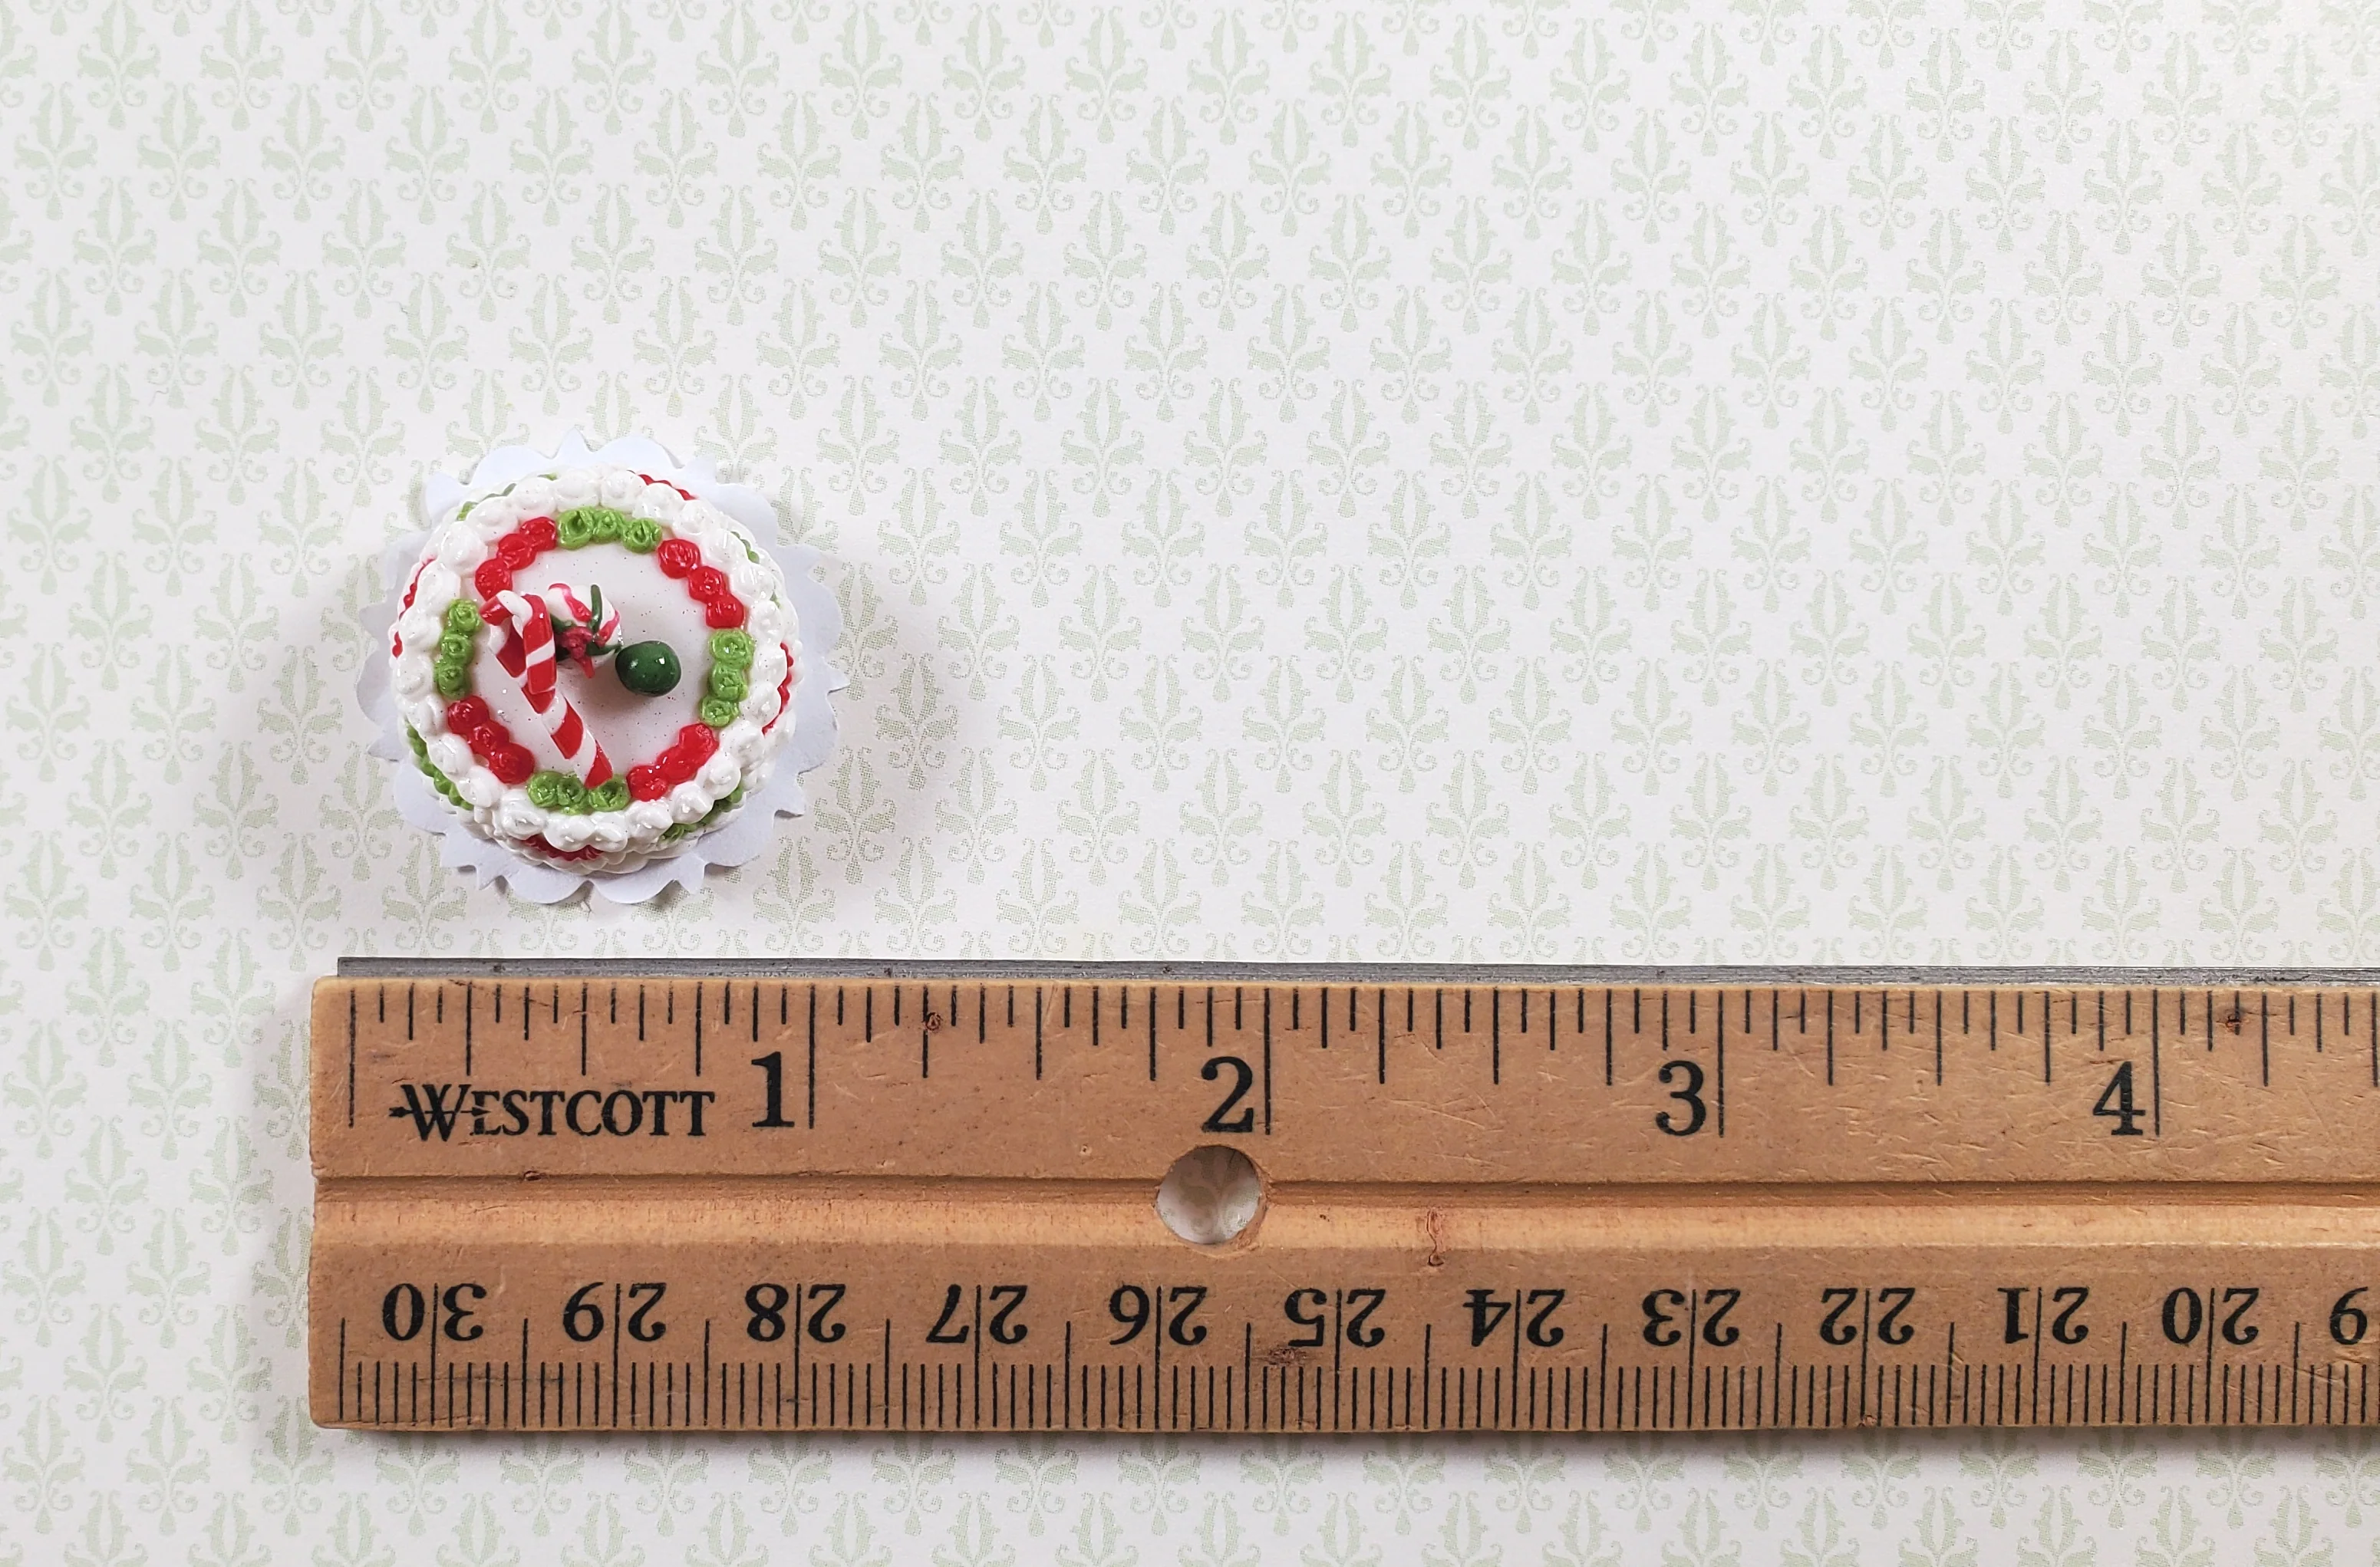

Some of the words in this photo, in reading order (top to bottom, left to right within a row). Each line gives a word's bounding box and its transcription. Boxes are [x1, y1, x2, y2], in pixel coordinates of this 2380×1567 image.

[389, 1084, 715, 1142] WESTCOTT
[751, 1052, 795, 1128] 1
[1200, 1056, 1254, 1133] 2
[1656, 1060, 1706, 1136] 3
[2093, 1062, 2145, 1135] 4
